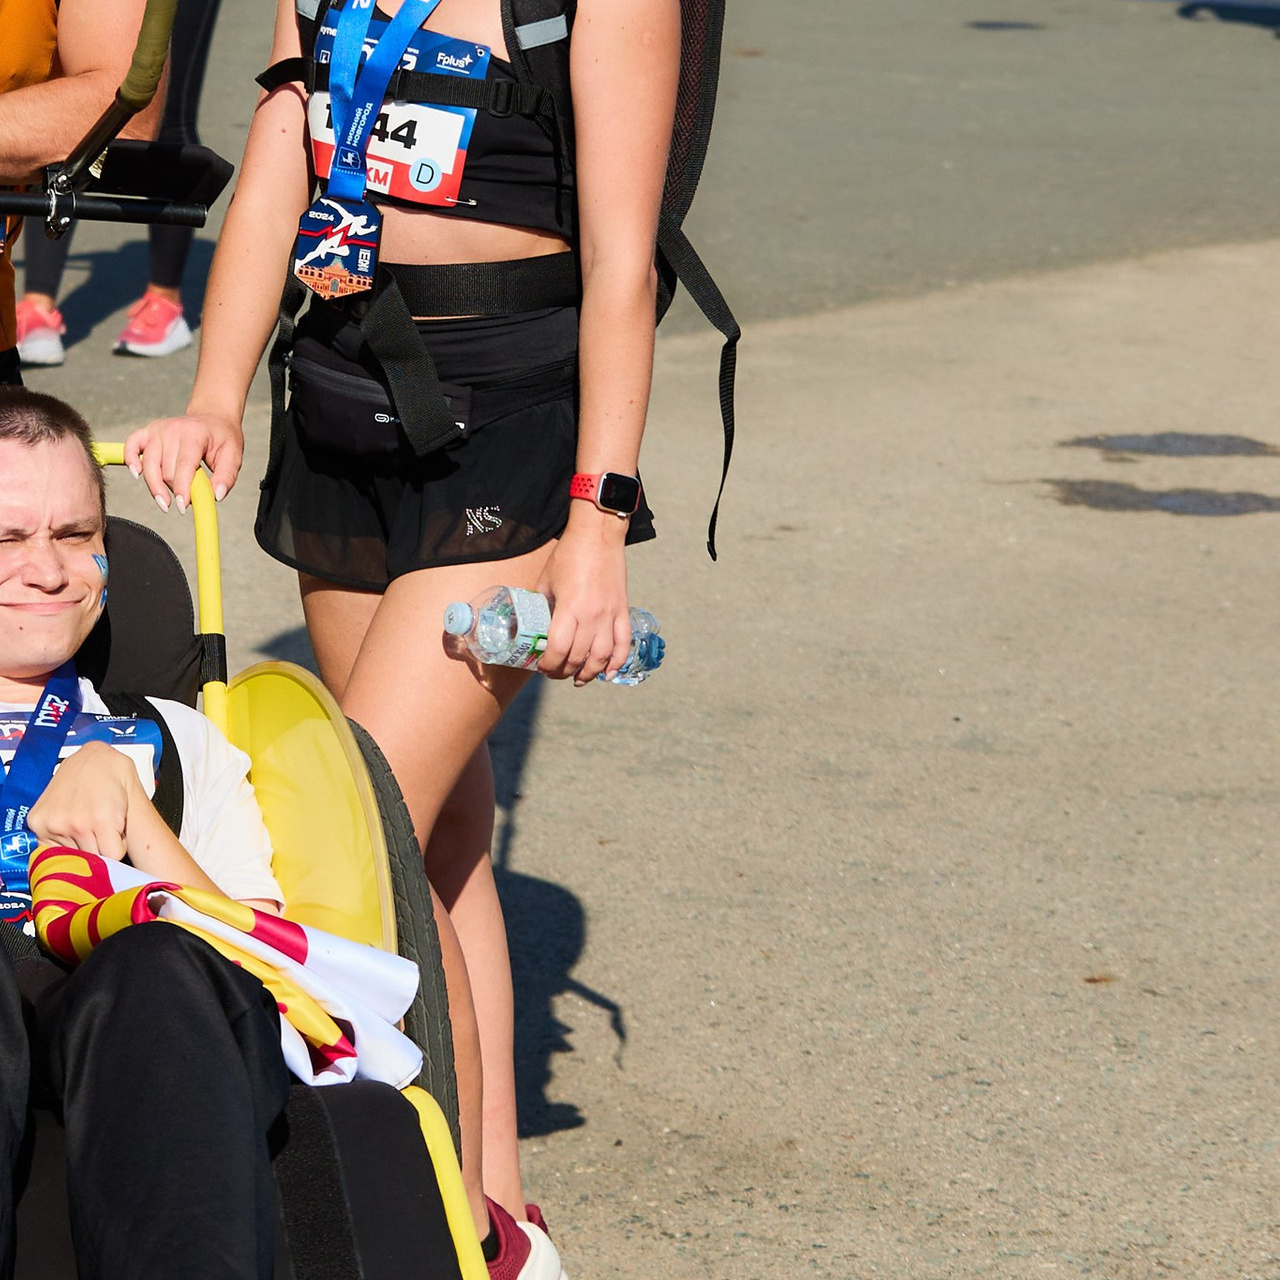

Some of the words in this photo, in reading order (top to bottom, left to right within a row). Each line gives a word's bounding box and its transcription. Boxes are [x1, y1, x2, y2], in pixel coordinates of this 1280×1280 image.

[326, 103, 418, 150] 144
[346, 107, 363, 145] НИЖНИЙ
[352, 102, 374, 147] НОВГОРОД
[416, 162, 434, 185] D
[308, 210, 335, 221] 2024
